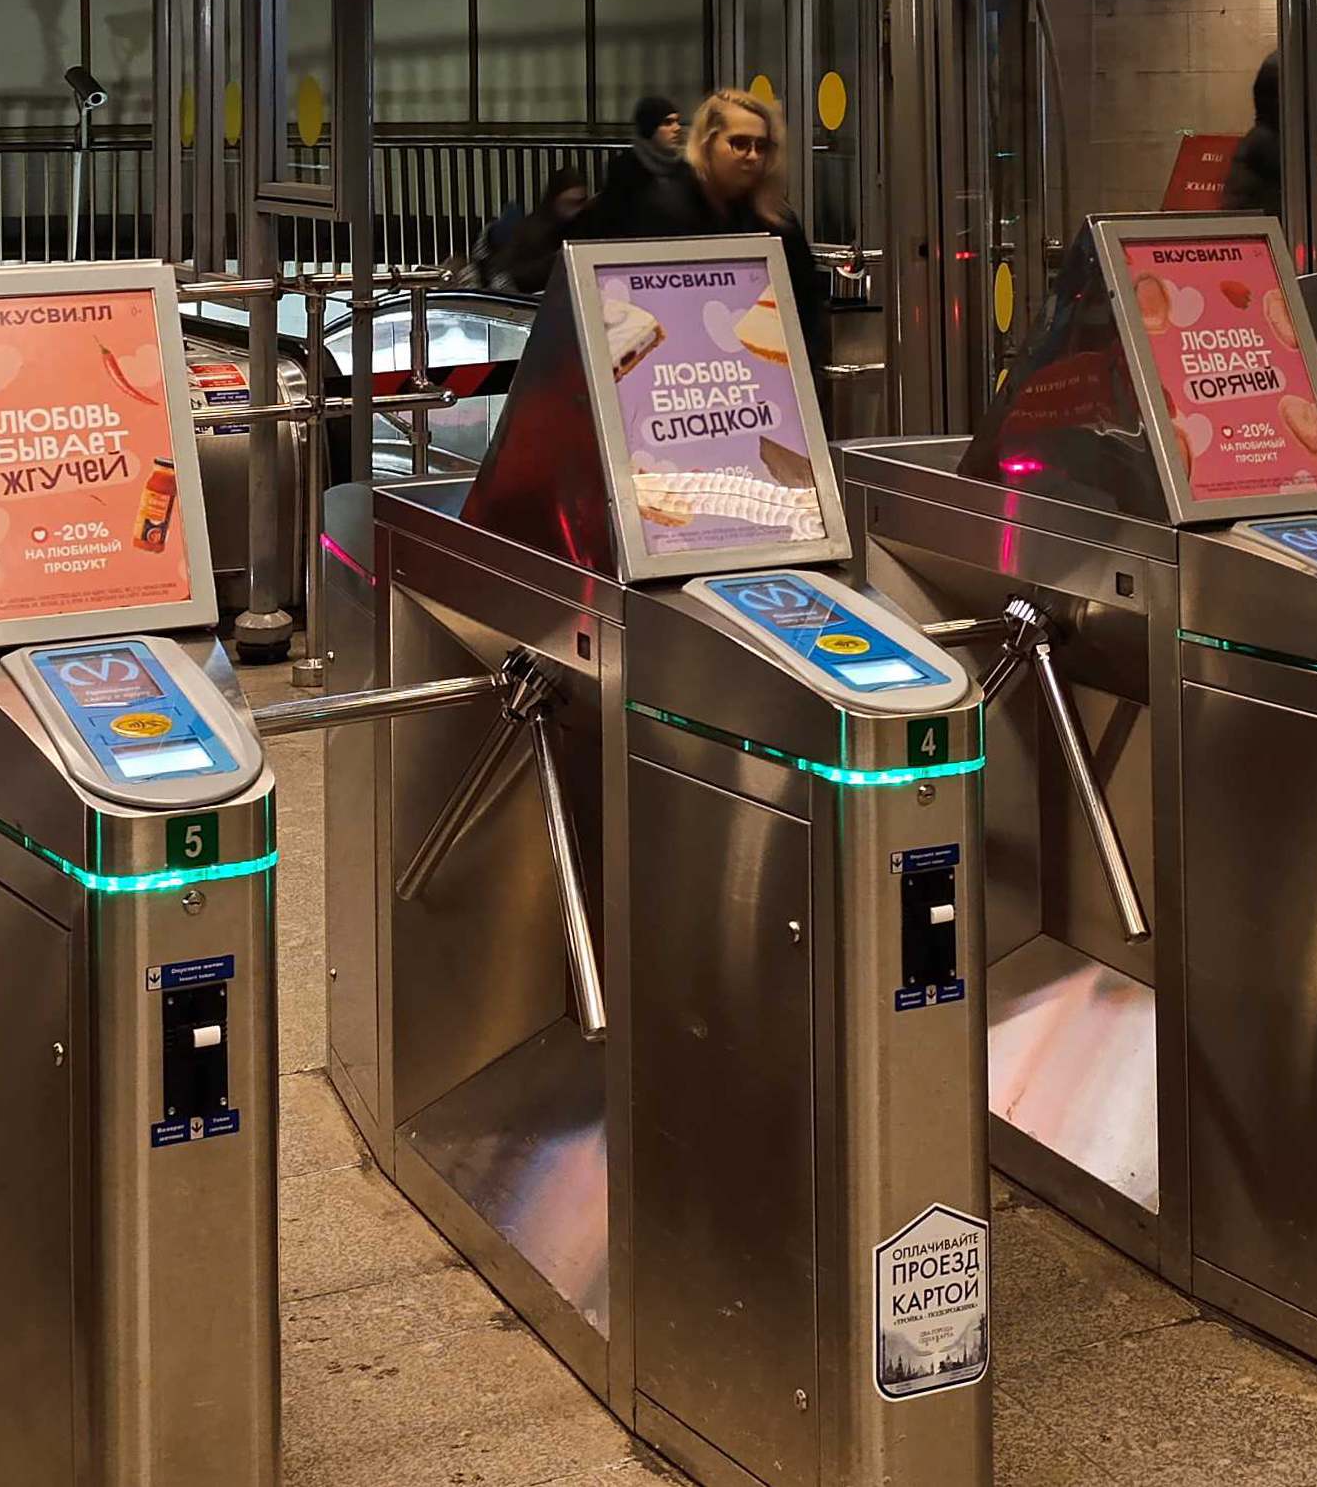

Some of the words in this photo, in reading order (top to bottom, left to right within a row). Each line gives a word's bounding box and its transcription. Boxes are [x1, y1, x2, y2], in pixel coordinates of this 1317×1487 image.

[1152, 247, 1243, 264] ВКУСВИЛЛ
[630, 271, 736, 291] ВКУСВИЛЛ
[1181, 327, 1264, 351] ЛЮБОВЬ
[652, 359, 751, 388] ЛЮБОВЬ
[1237, 422, 1275, 438] -20%
[1235, 452, 1277, 463] ПРОДУКТ
[53, 521, 109, 542] -20%
[25, 547, 46, 561] НА
[47, 539, 122, 560] ЛЮБИМЫЙ
[44, 556, 108, 574] ПРОДУКТ
[920, 727, 936, 757] 4
[184, 825, 202, 858] 5
[892, 1232, 979, 1261] ОПЛАЧИВАЙТЕ
[892, 1247, 980, 1286] ПРОЕЗД
[892, 1272, 979, 1317] КАРТОЙ
